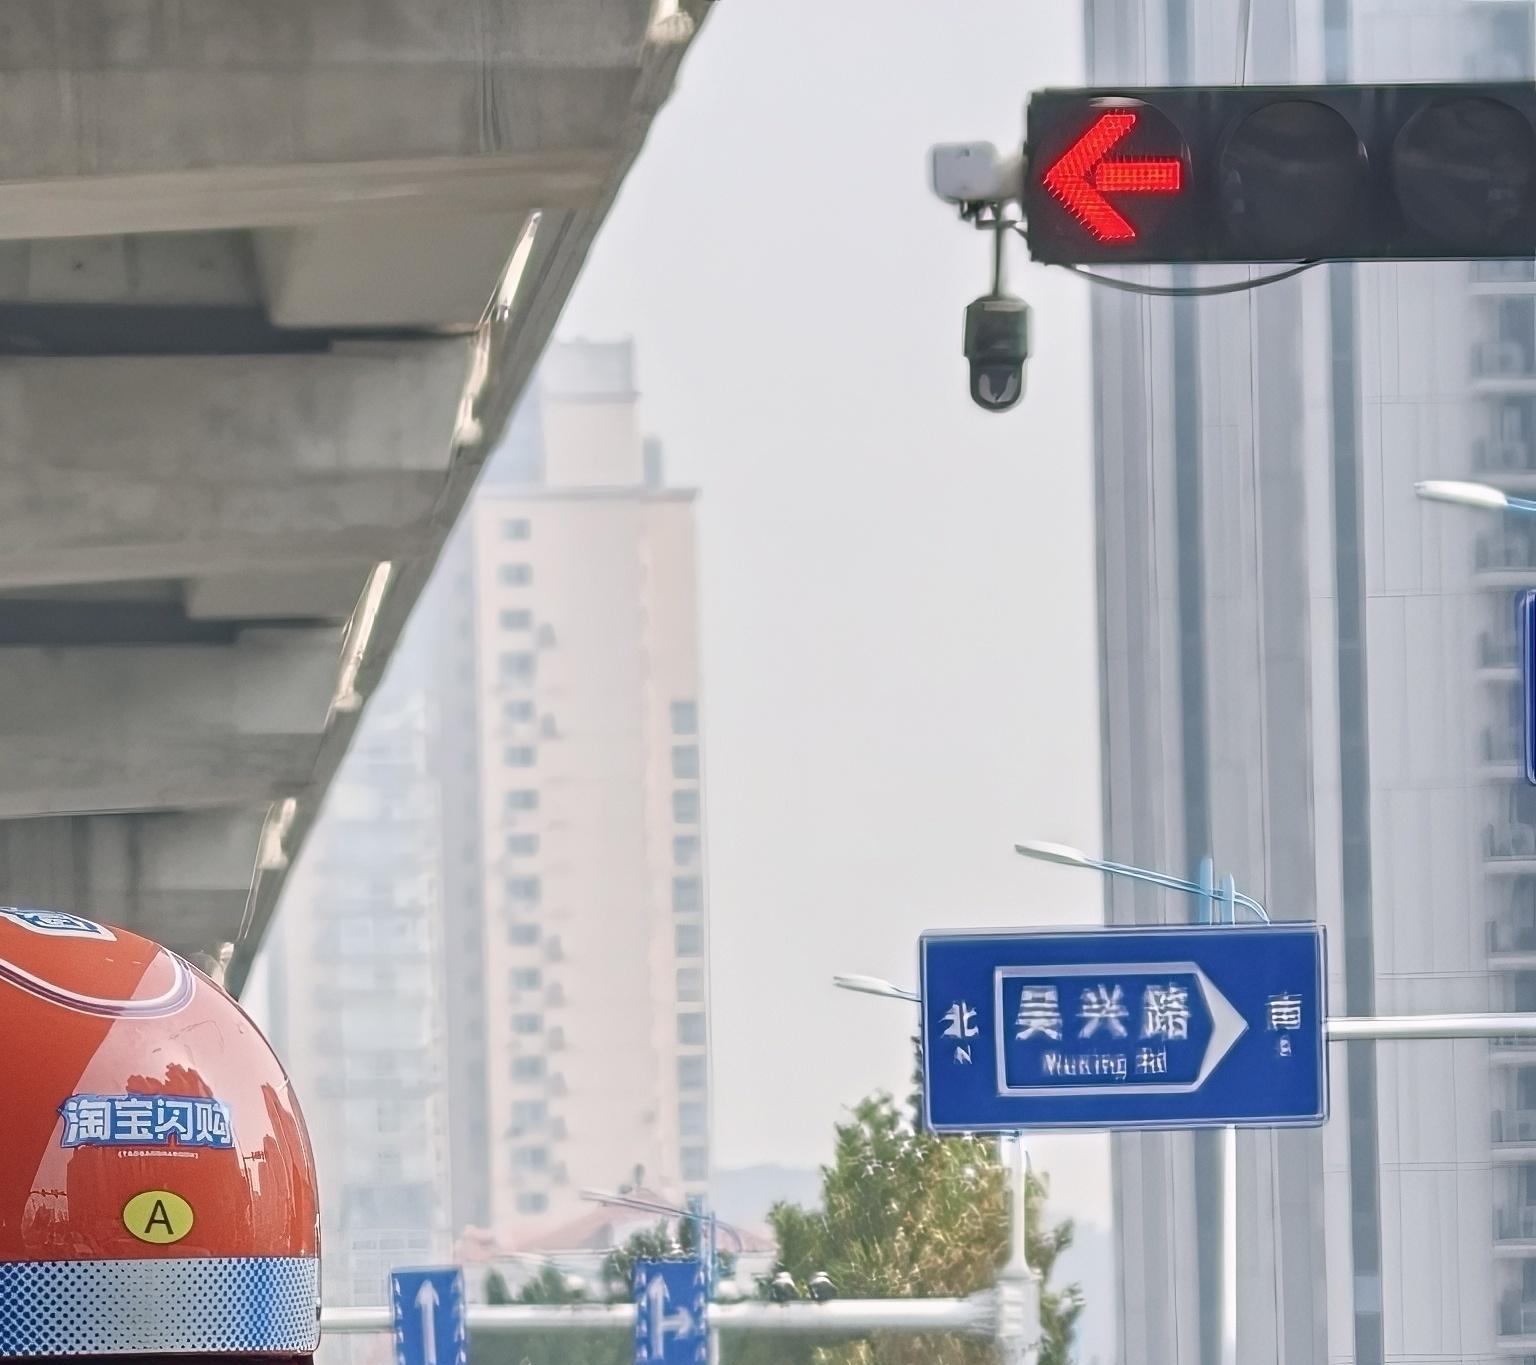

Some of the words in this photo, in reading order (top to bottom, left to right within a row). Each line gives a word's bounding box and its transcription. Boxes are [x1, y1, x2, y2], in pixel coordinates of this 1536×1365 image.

[939, 1000, 979, 1039] 北
[1014, 982, 1192, 1041] 吴兴路
[1268, 992, 1303, 1030] 南
[954, 1044, 972, 1065] N
[66, 1098, 231, 1144] 淘宝闪购
[144, 1199, 174, 1235] A
